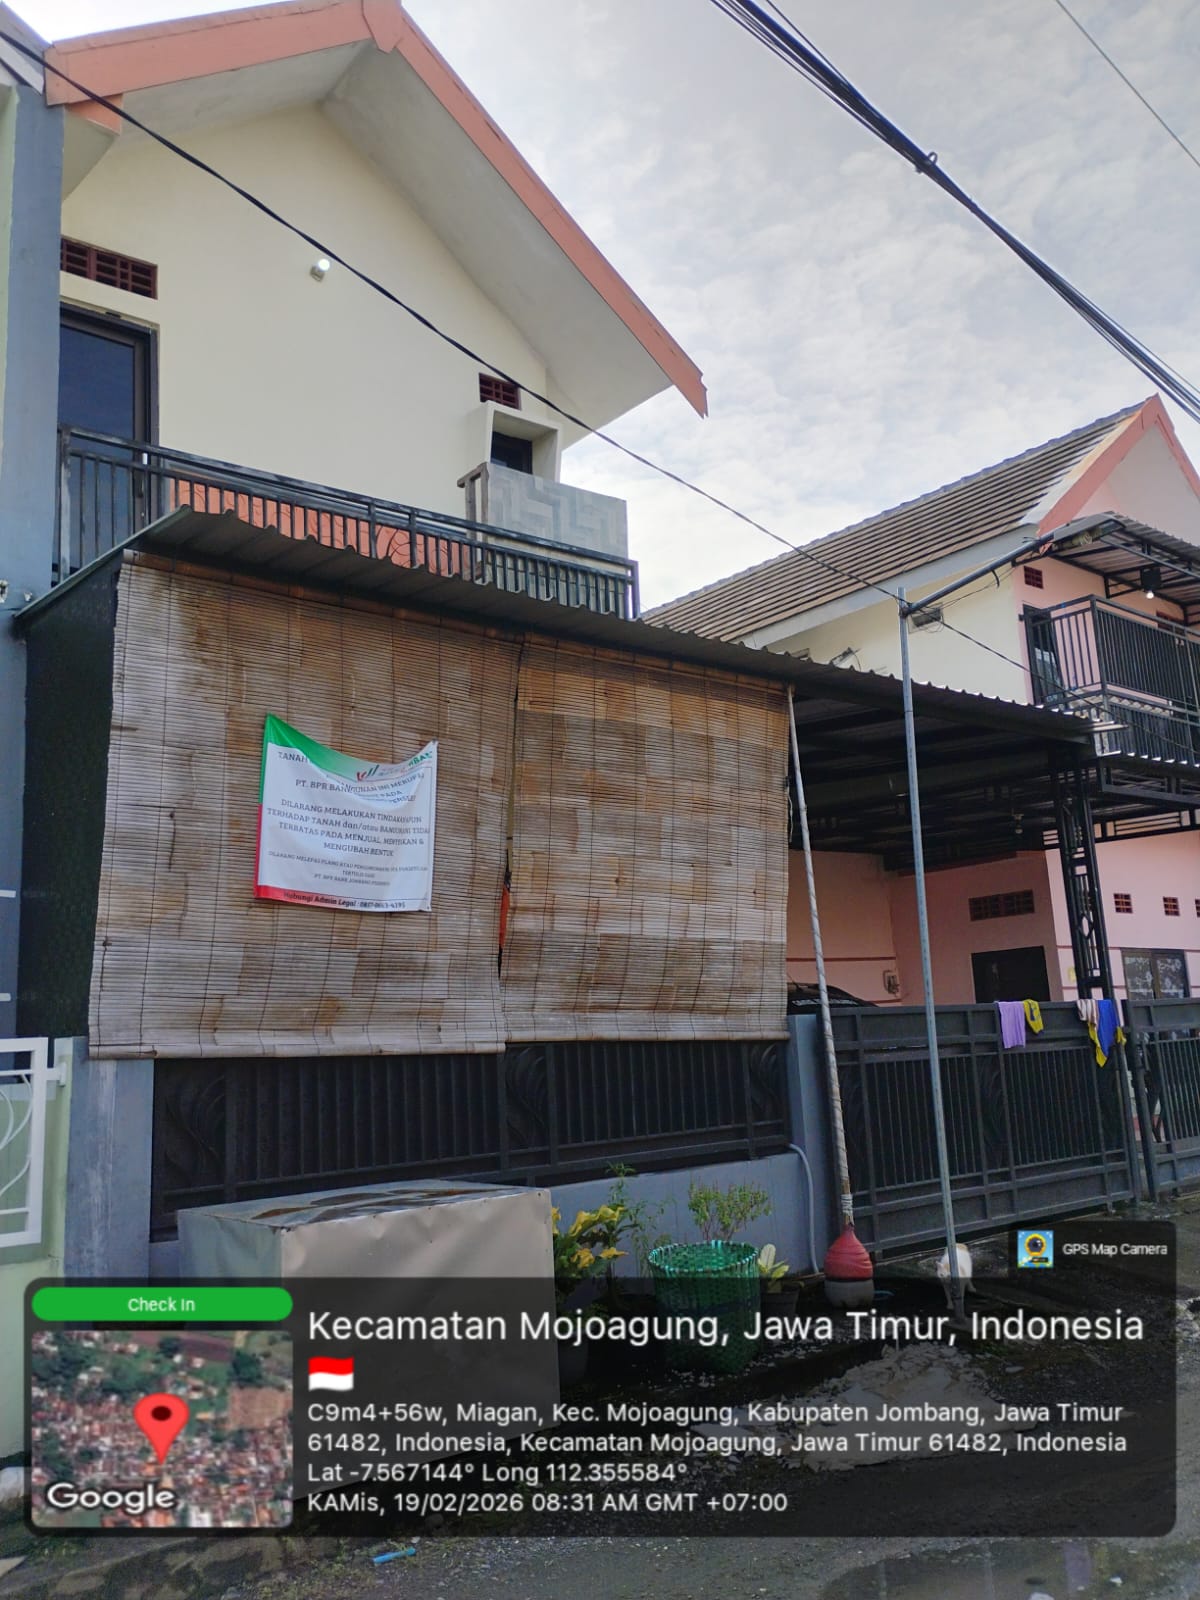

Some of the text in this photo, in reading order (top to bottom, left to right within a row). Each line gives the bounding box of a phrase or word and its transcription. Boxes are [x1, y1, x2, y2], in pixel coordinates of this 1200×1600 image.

[267, 808, 310, 822] TERHADAP
[312, 817, 341, 827] TANAH
[281, 799, 323, 814] DILARANG
[324, 806, 376, 820] MELAKUKAN
[279, 822, 319, 836] TERBATAS
[320, 830, 343, 840] PADA
[324, 842, 369, 854] MENGUBAH
